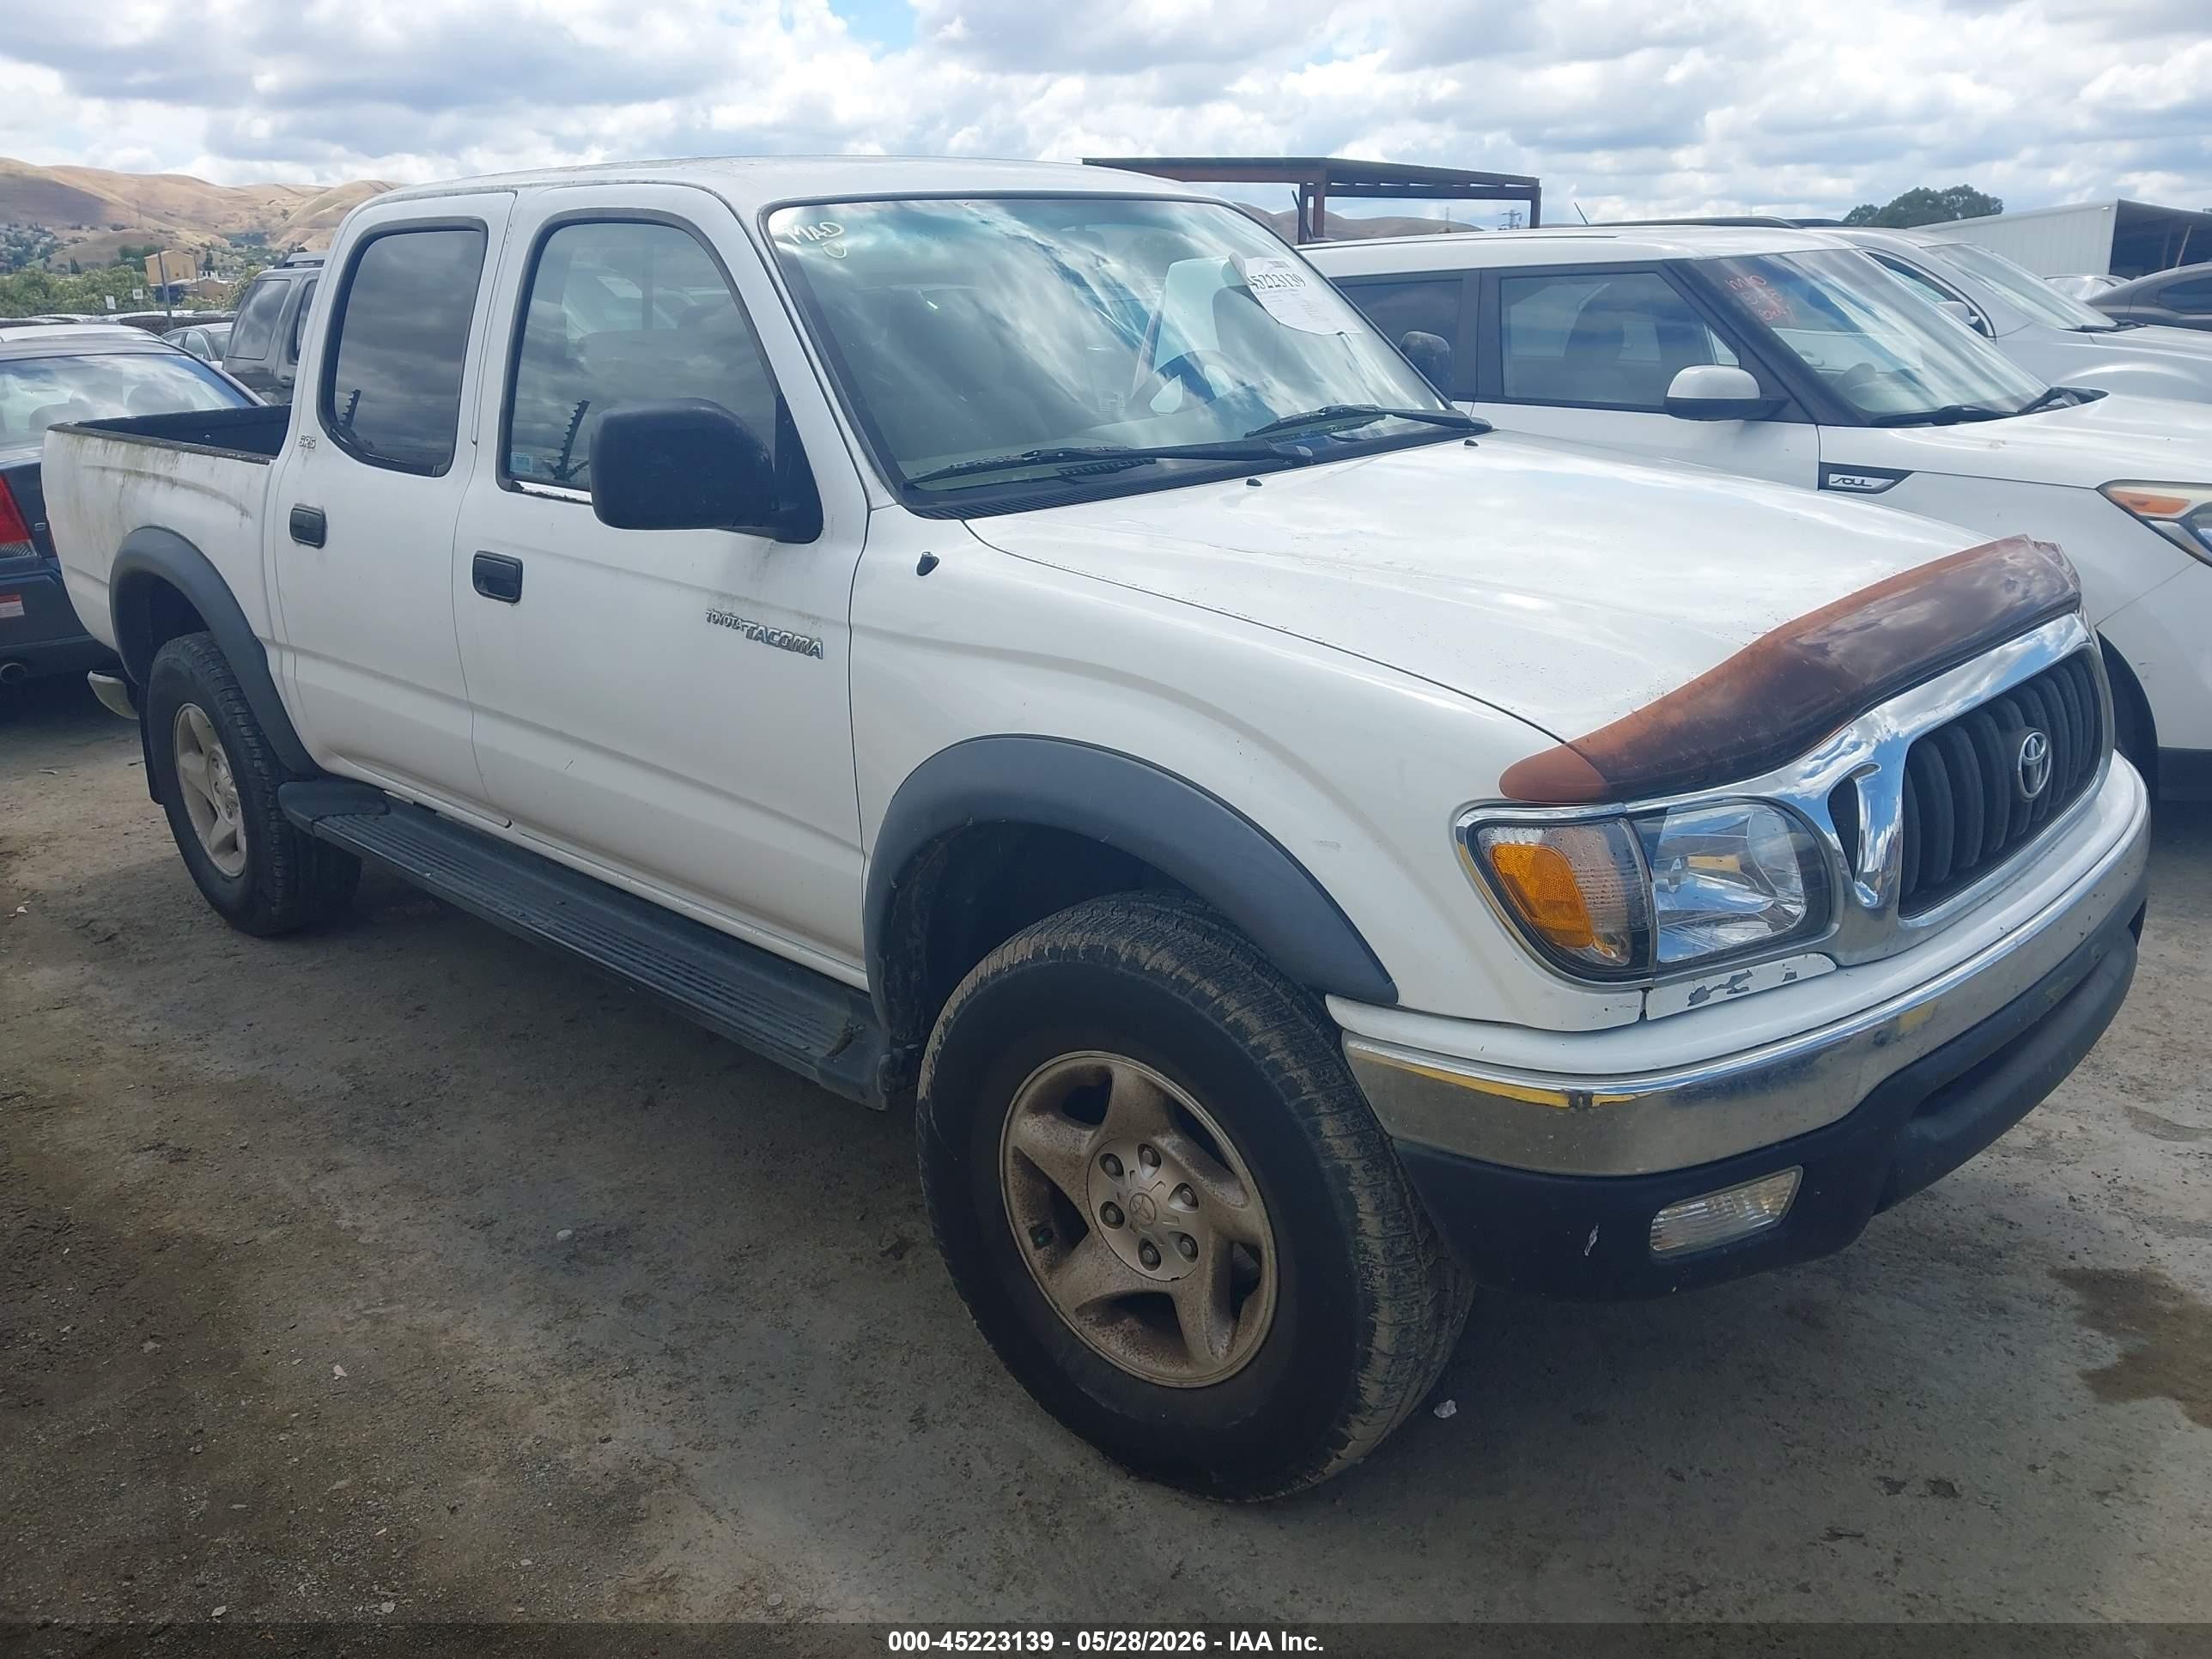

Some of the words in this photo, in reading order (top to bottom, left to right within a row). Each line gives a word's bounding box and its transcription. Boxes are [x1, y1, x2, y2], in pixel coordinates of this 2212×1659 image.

[299, 434, 316, 449] SR5
[1830, 477, 1873, 487] SOUL
[706, 609, 744, 631] TOYOTA
[743, 620, 823, 659] TACOMA
